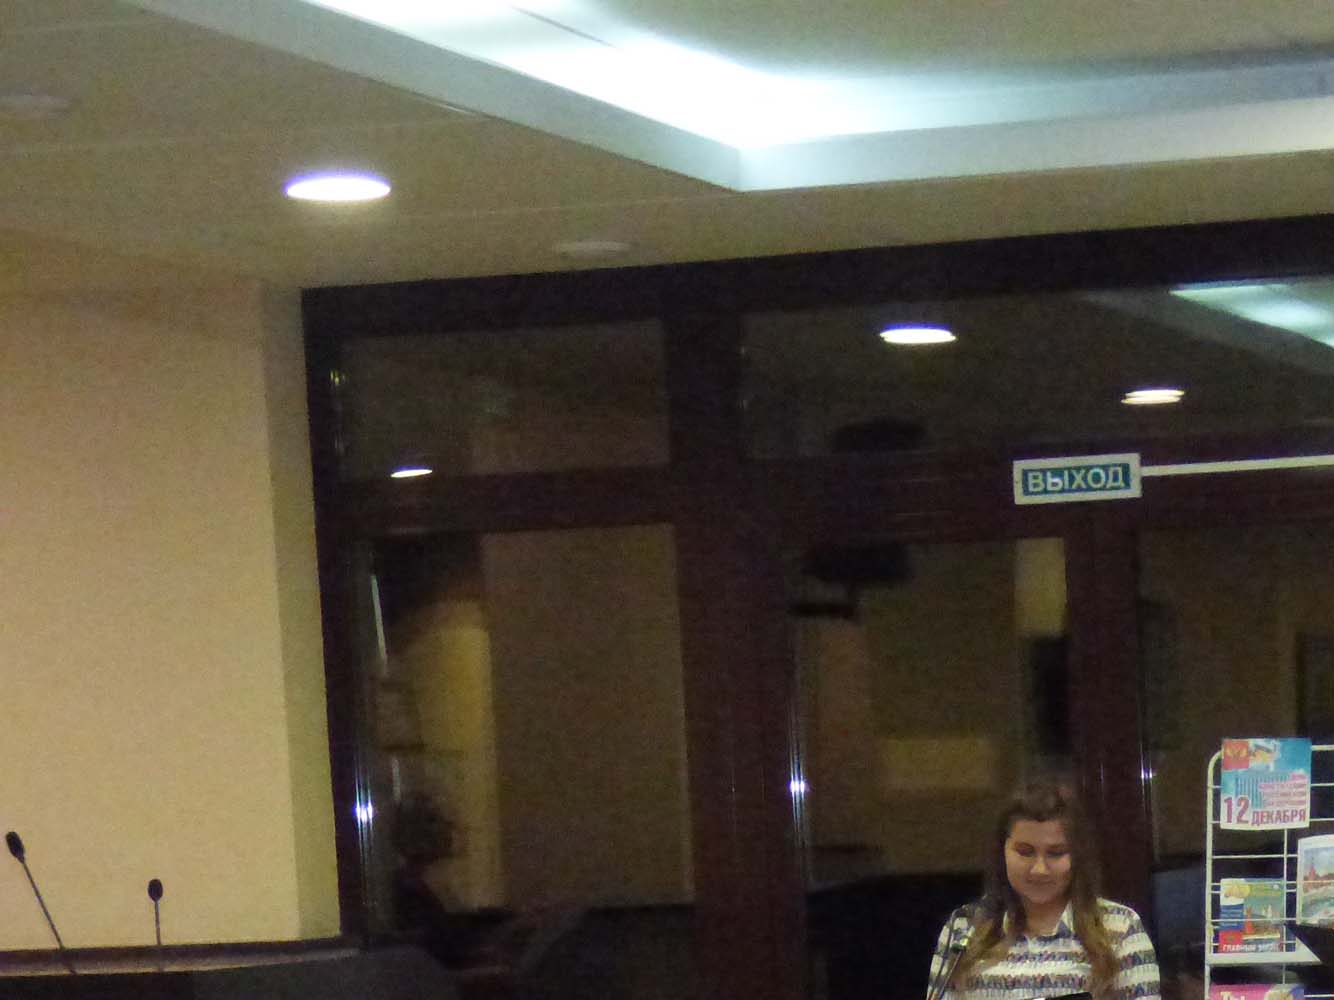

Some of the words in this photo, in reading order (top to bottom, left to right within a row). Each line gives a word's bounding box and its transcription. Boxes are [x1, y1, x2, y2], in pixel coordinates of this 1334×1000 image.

[1028, 466, 1125, 492] ВЫХОД
[1223, 795, 1249, 824] 12
[1251, 808, 1306, 826] ДЕКАБРЯ
